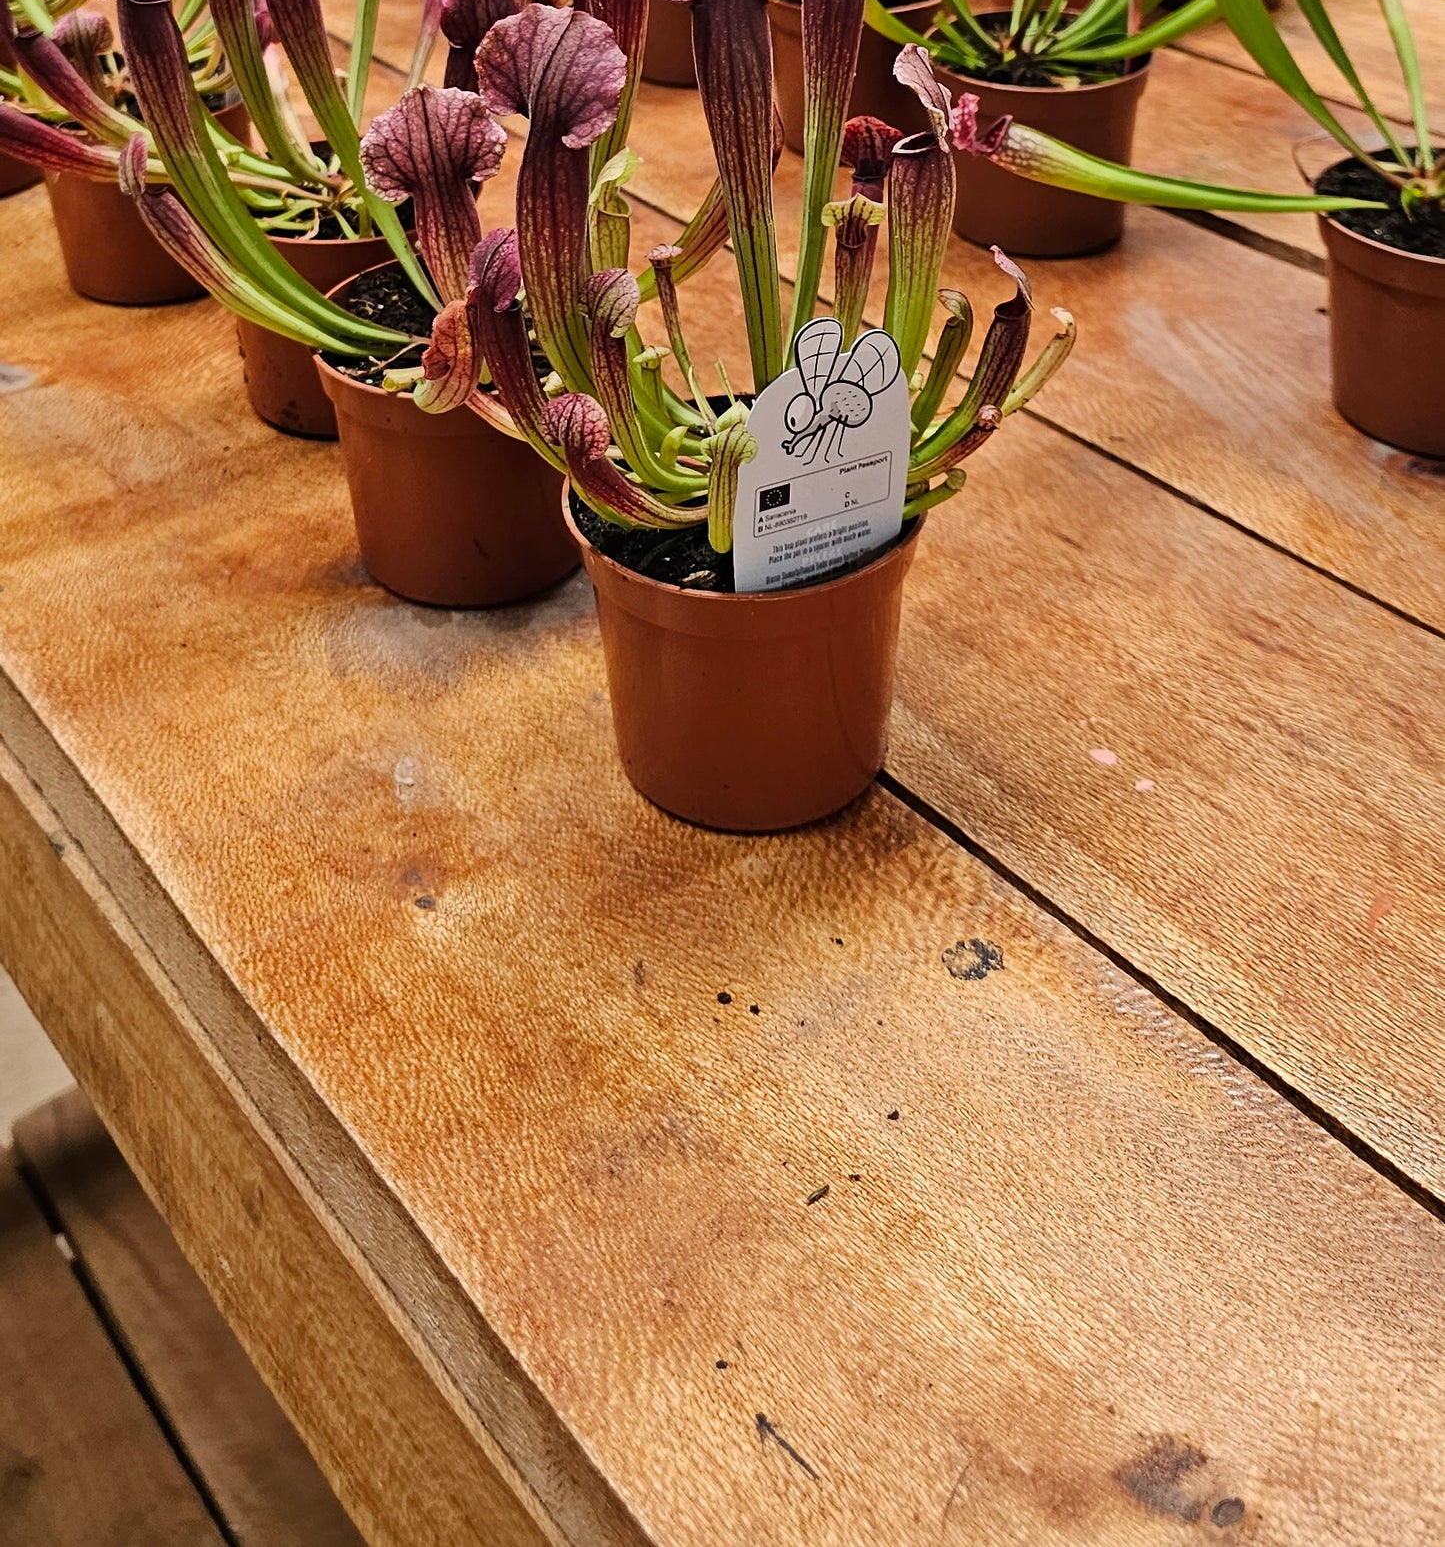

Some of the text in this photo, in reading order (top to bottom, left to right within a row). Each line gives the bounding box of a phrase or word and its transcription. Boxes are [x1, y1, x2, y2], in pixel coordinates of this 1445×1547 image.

[839, 455, 888, 475] Plant Passport
[844, 491, 851, 499] C
[844, 498, 860, 508] D NL
[758, 508, 797, 524] A Sarracenia
[758, 525, 764, 533] B
[769, 555, 783, 565] Place
